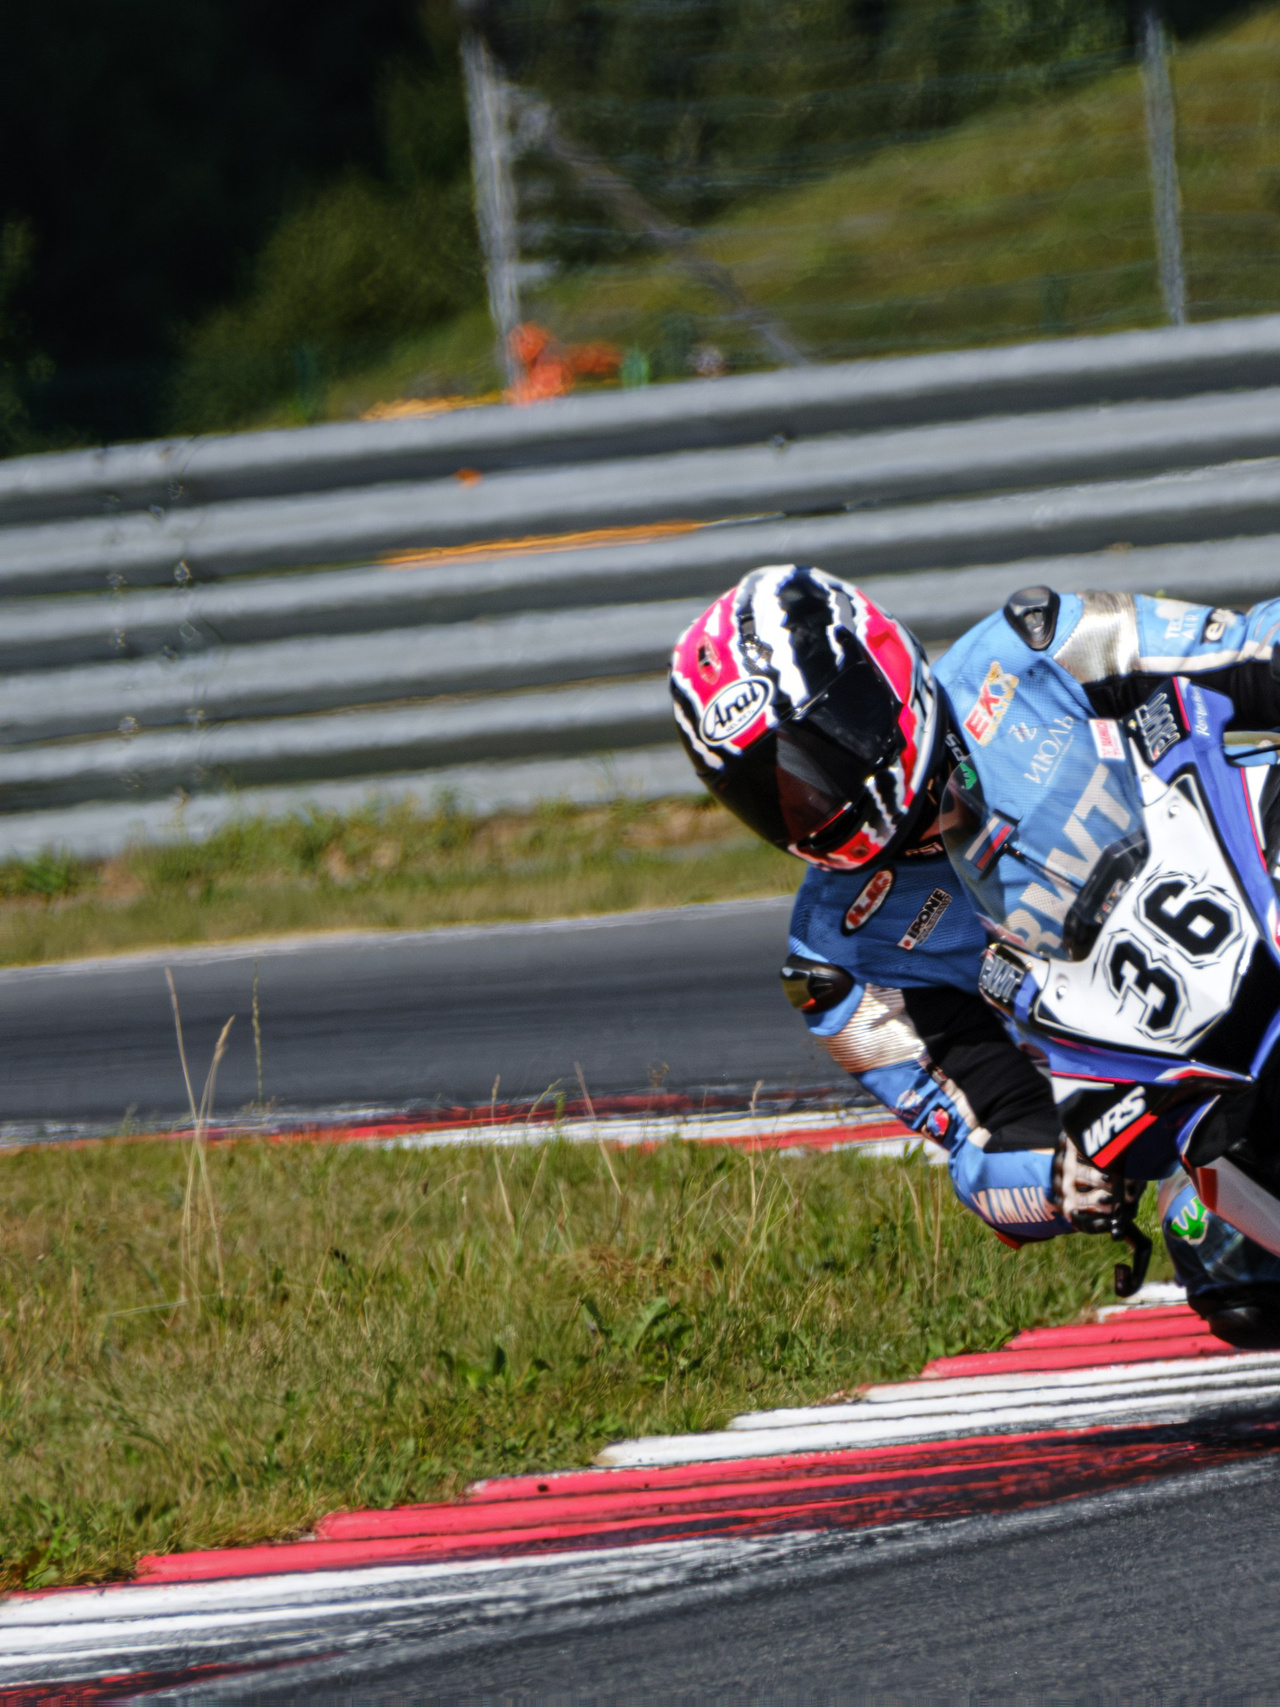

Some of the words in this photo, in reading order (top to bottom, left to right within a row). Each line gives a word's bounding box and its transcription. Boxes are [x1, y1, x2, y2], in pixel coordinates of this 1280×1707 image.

[710, 681, 761, 739] Arai
[907, 889, 946, 940] IPONE
[1108, 876, 1236, 1036] 36
[1083, 1085, 1147, 1158] WRS
